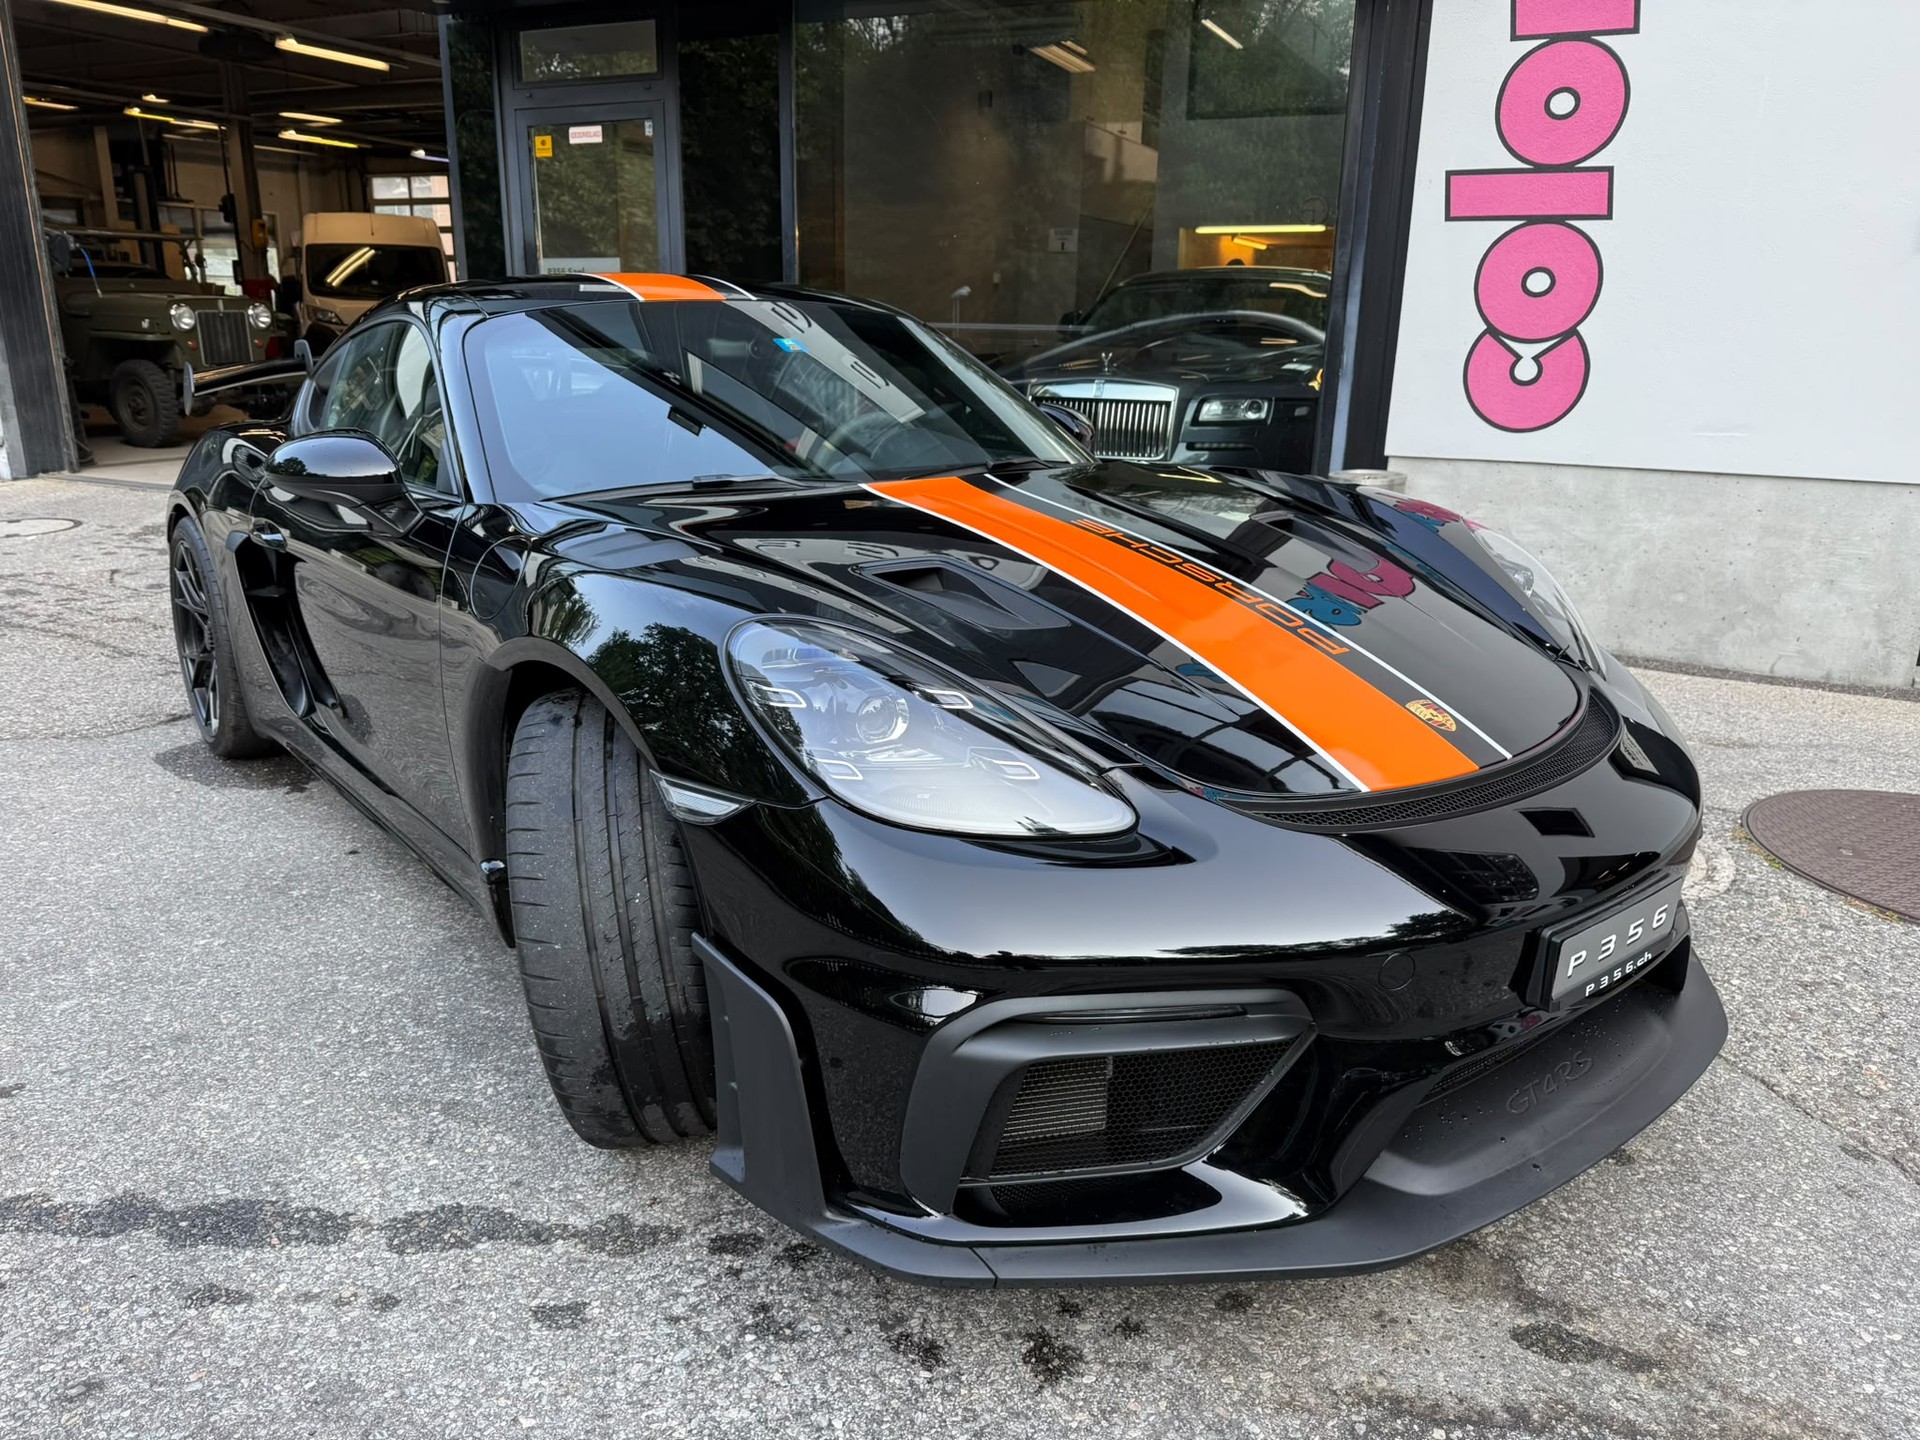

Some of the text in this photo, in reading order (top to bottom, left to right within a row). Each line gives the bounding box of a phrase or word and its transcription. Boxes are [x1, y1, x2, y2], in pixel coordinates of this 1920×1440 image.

[1070, 518, 1351, 656] PORSCHE
[1566, 903, 1669, 978] P356
[1585, 951, 1652, 997] P356.ch
